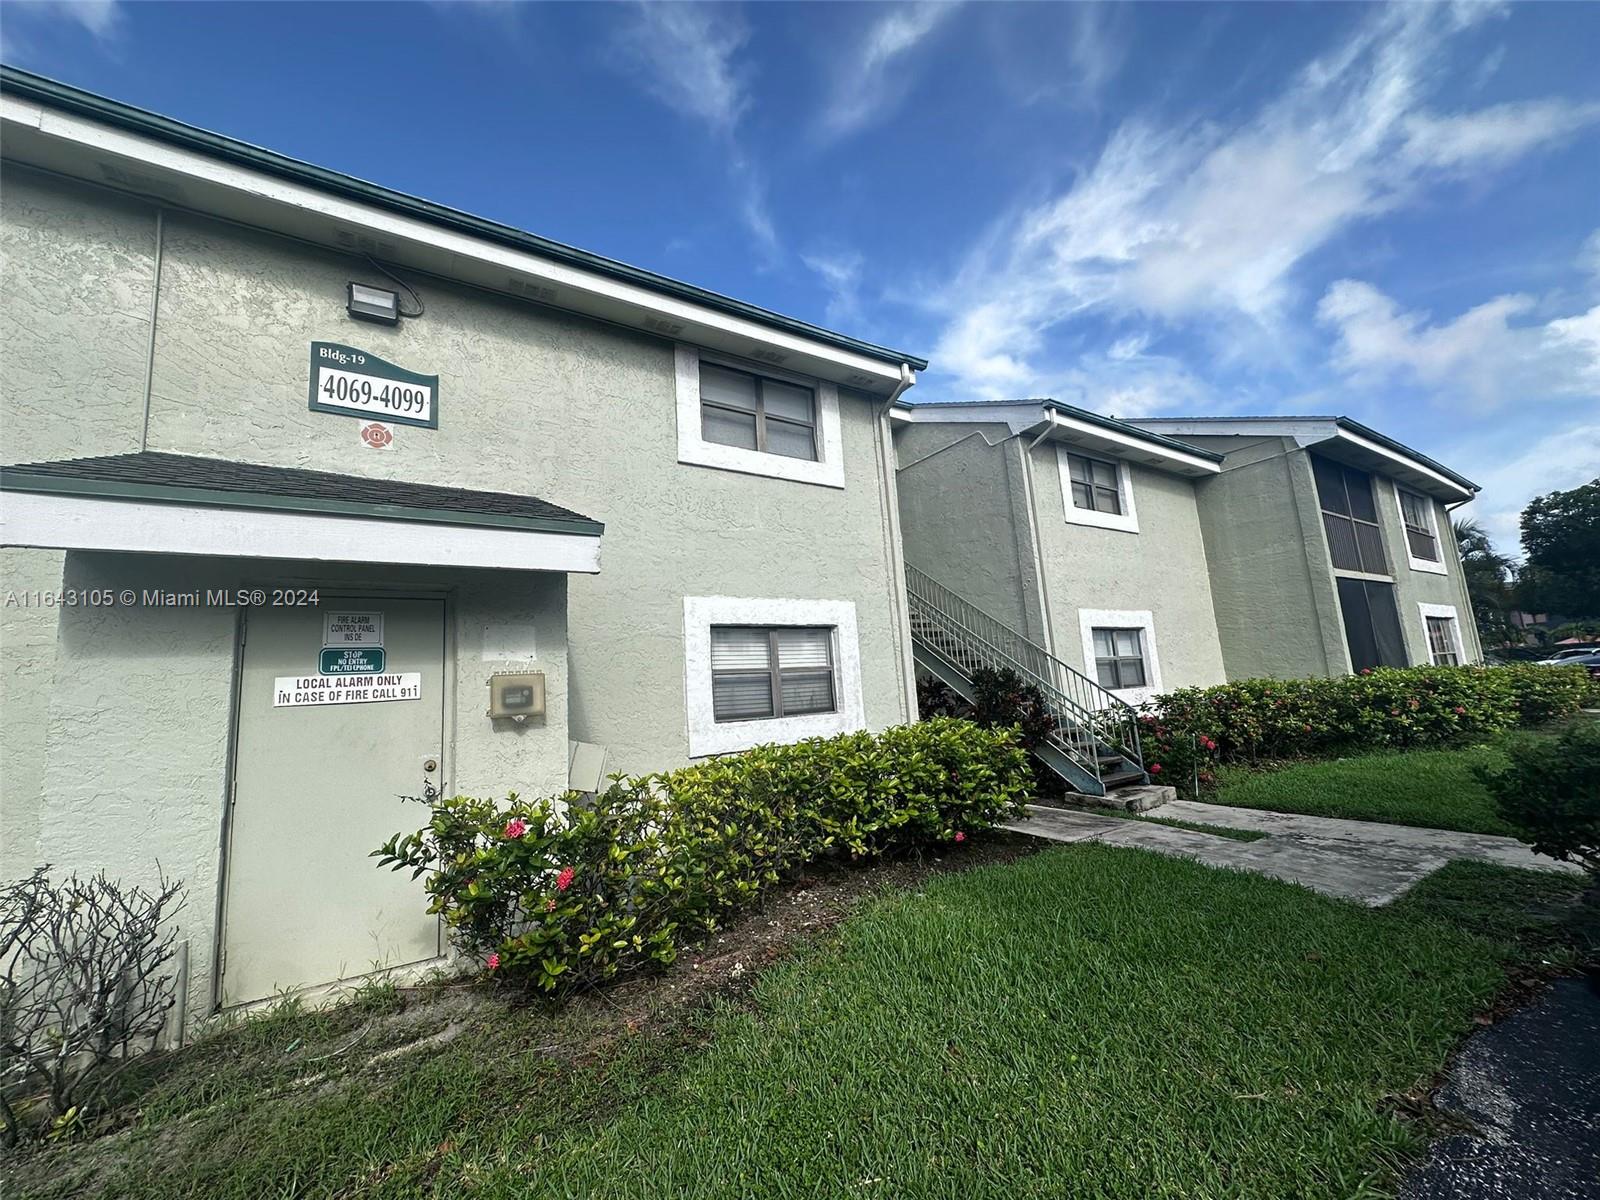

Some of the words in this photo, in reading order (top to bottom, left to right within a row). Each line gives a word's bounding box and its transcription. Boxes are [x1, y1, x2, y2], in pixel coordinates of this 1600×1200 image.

[320, 347, 366, 365] Bldg-19
[323, 374, 425, 414] 4069-4099
[337, 616, 350, 624] FIRE
[351, 616, 370, 624] ALARM
[331, 624, 356, 632] CONTROL
[358, 624, 375, 632] PANEL
[344, 633, 362, 641] INSDE
[343, 650, 363, 659] STOP
[296, 678, 332, 690] LOCAL
[335, 676, 374, 688] ALARM
[377, 675, 403, 686] ONLY
[278, 692, 291, 704] IN
[294, 690, 325, 703] CASE
[328, 690, 342, 701] OF
[345, 689, 369, 700] FIRE
[372, 688, 398, 699] CALL
[400, 687, 418, 697] 911
